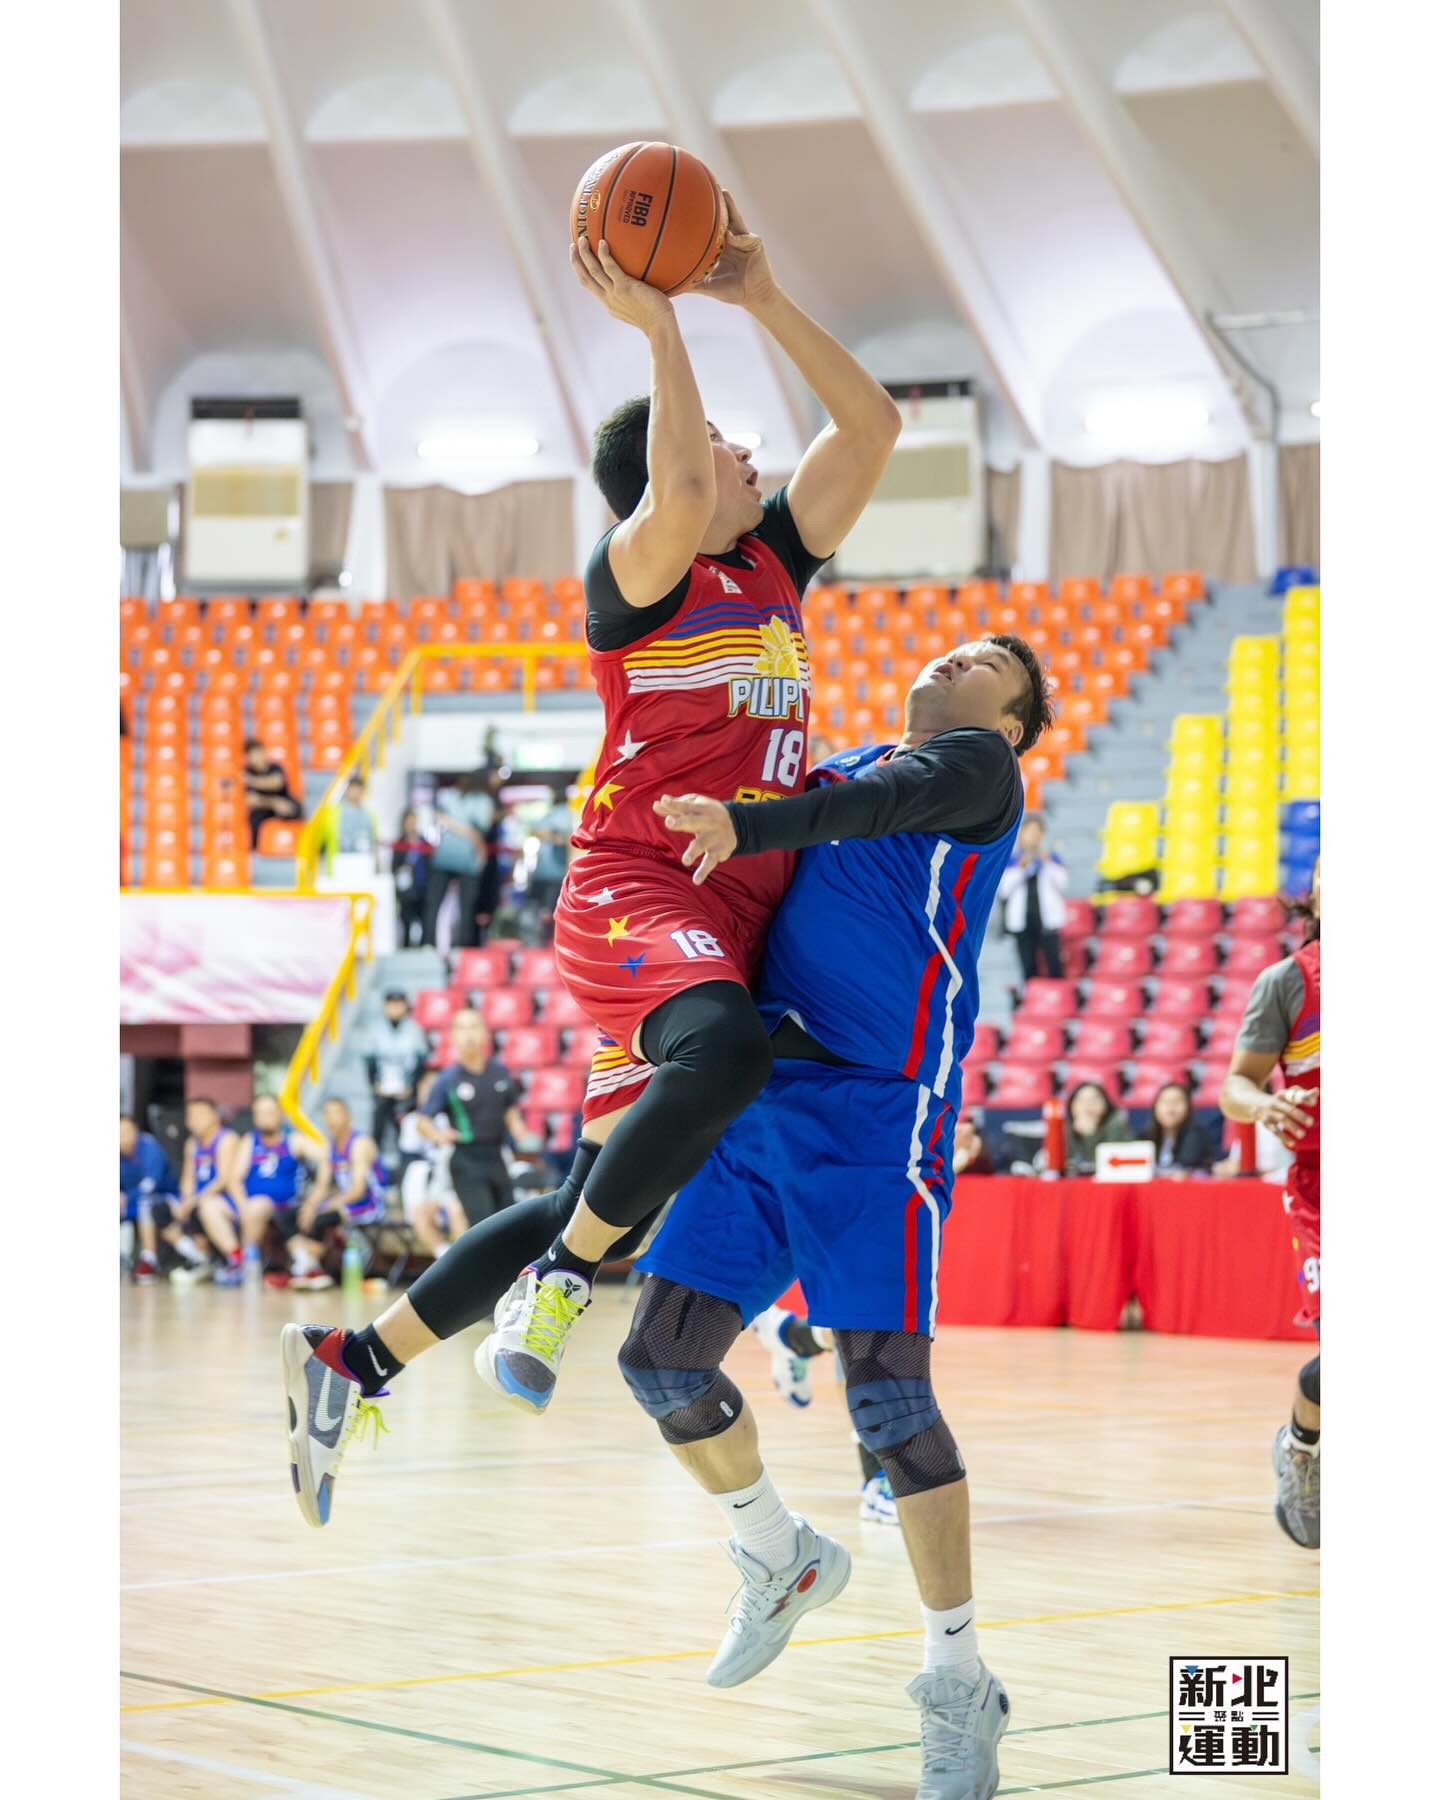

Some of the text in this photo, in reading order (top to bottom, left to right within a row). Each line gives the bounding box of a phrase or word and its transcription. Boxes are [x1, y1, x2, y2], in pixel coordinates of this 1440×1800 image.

[622, 190, 638, 224] APPROVED
[631, 191, 653, 227] FIBA
[761, 728, 804, 788] 18
[669, 929, 725, 959] 18
